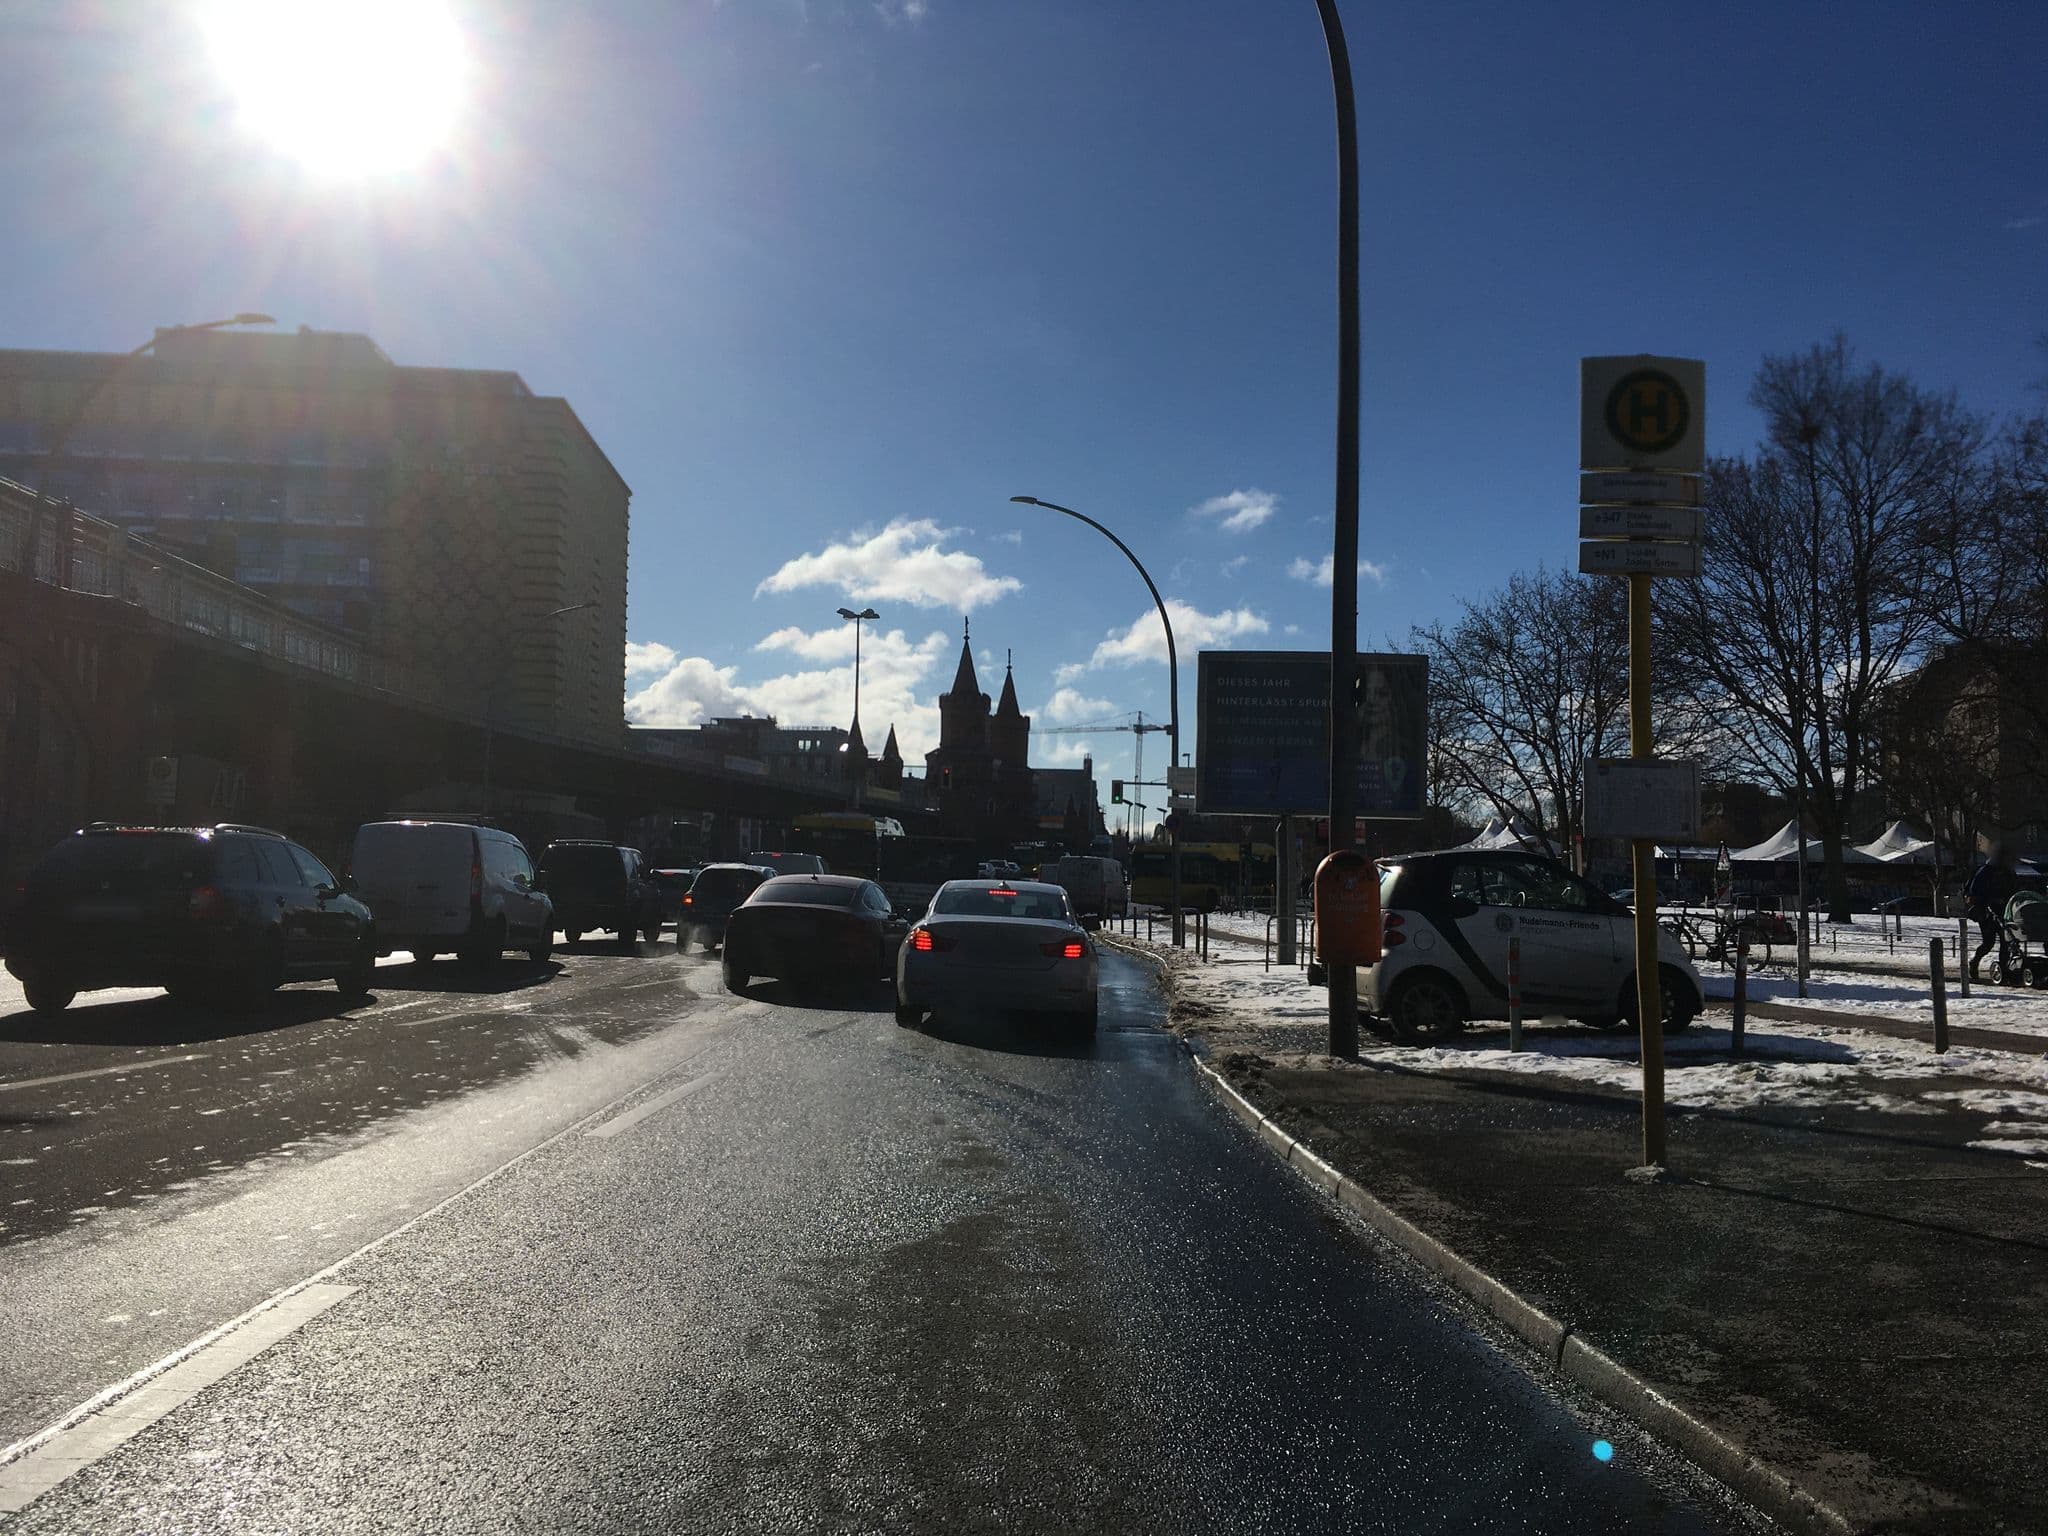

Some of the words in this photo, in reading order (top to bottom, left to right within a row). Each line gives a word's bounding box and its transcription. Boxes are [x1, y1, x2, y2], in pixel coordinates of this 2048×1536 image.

[1630, 390, 1666, 434] H
[1217, 677, 1258, 688] DIESES
[1263, 678, 1291, 688] JAHR
